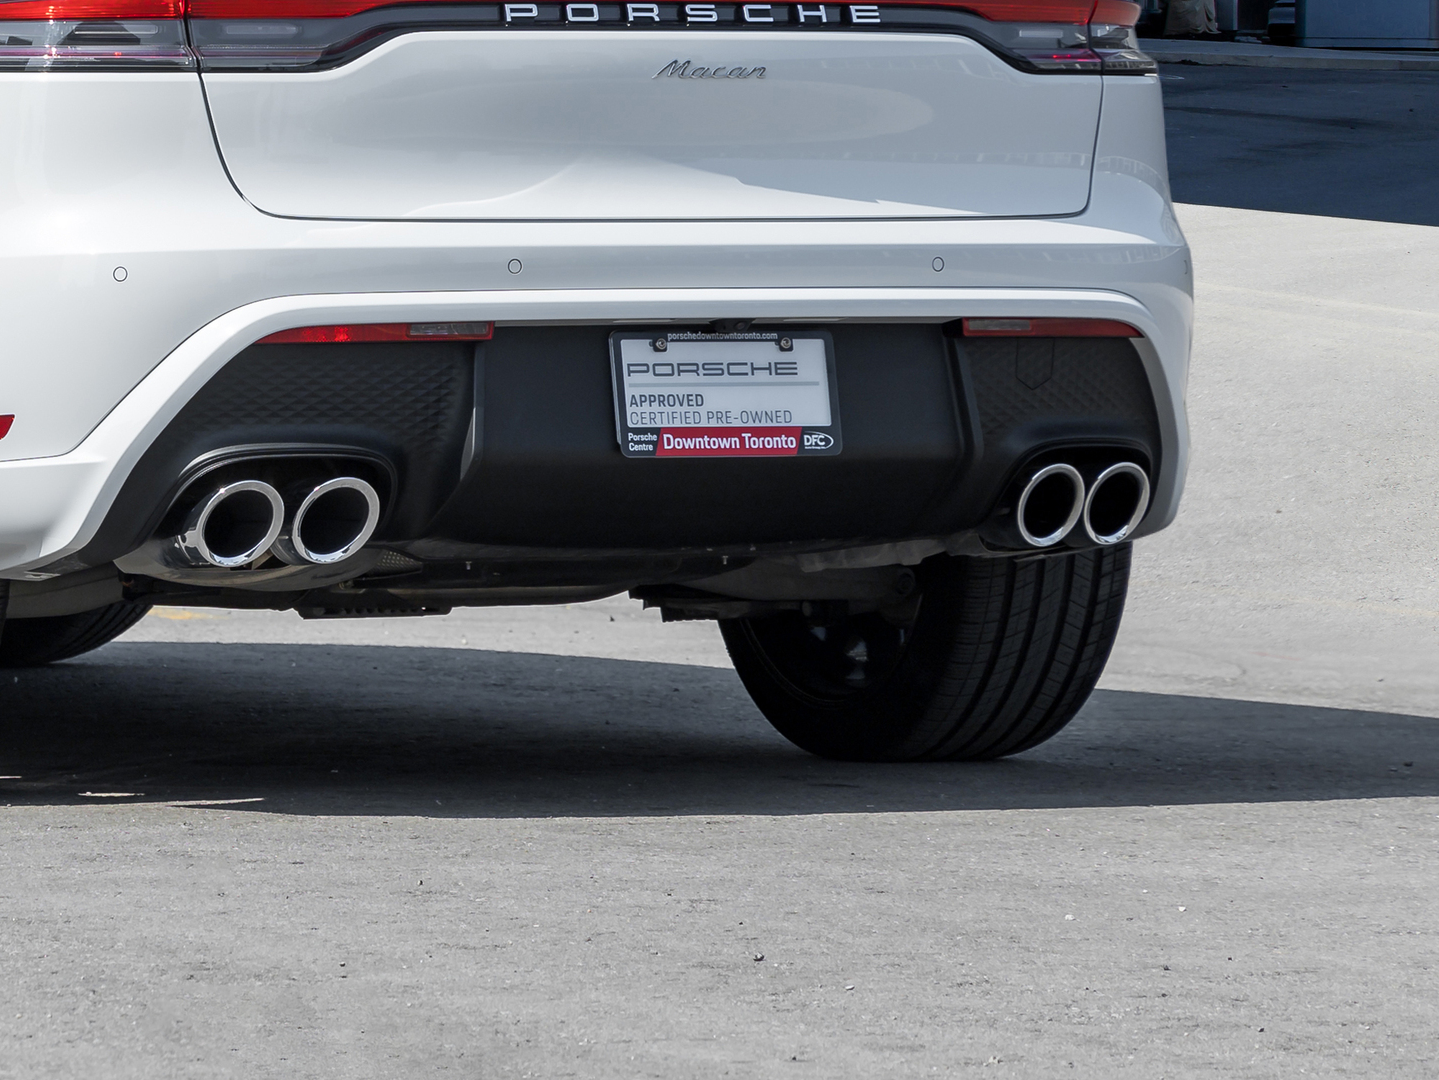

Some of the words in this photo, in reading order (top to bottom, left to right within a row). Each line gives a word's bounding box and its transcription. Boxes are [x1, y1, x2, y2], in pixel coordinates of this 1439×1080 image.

[504, 3, 882, 23] PORSCHE
[651, 58, 767, 80] Macan
[667, 332, 778, 341] porschedowntowntoronto.com
[626, 361, 798, 377] PORSCHE
[629, 393, 704, 408] APPROVED
[630, 411, 702, 426] CERTIFIED
[707, 410, 793, 424] PRE-OWNED
[628, 432, 657, 442] Porsche
[663, 433, 740, 450] Downtown
[742, 433, 797, 450] Toronto
[803, 434, 826, 446] DFC
[628, 442, 653, 451] Centre
